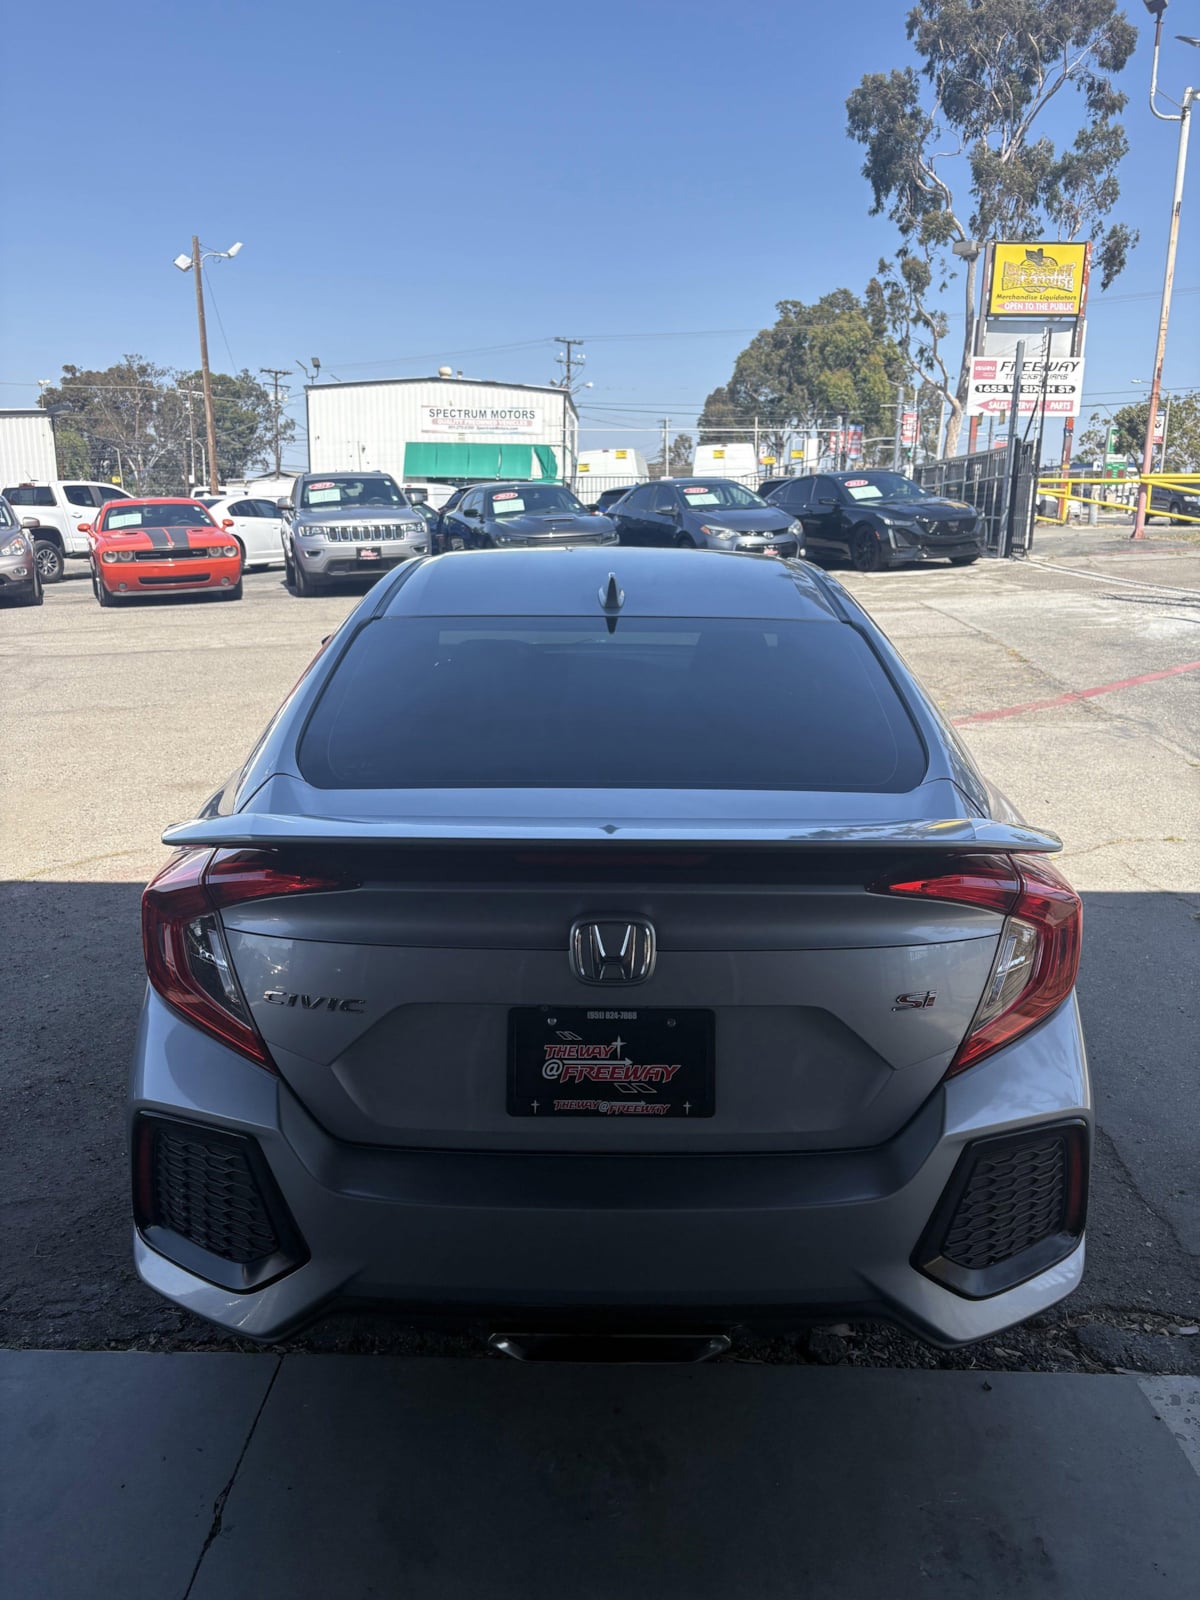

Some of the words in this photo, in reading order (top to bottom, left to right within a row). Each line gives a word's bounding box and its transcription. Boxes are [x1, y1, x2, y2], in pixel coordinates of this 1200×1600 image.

[1004, 302, 1024, 310] OPEN
[1025, 302, 1034, 310] TO
[1035, 302, 1049, 310] THE
[1050, 302, 1074, 310] PUBLIC
[978, 385, 1004, 393] 1655
[1022, 385, 1055, 393] SIXH
[1058, 385, 1073, 393] ST.
[988, 402, 1008, 410] SALES
[1049, 402, 1071, 410] PARTS
[429, 408, 487, 419] SPECTRUM
[490, 410, 536, 420] MOTORS
[263, 990, 366, 1014] CIVIC
